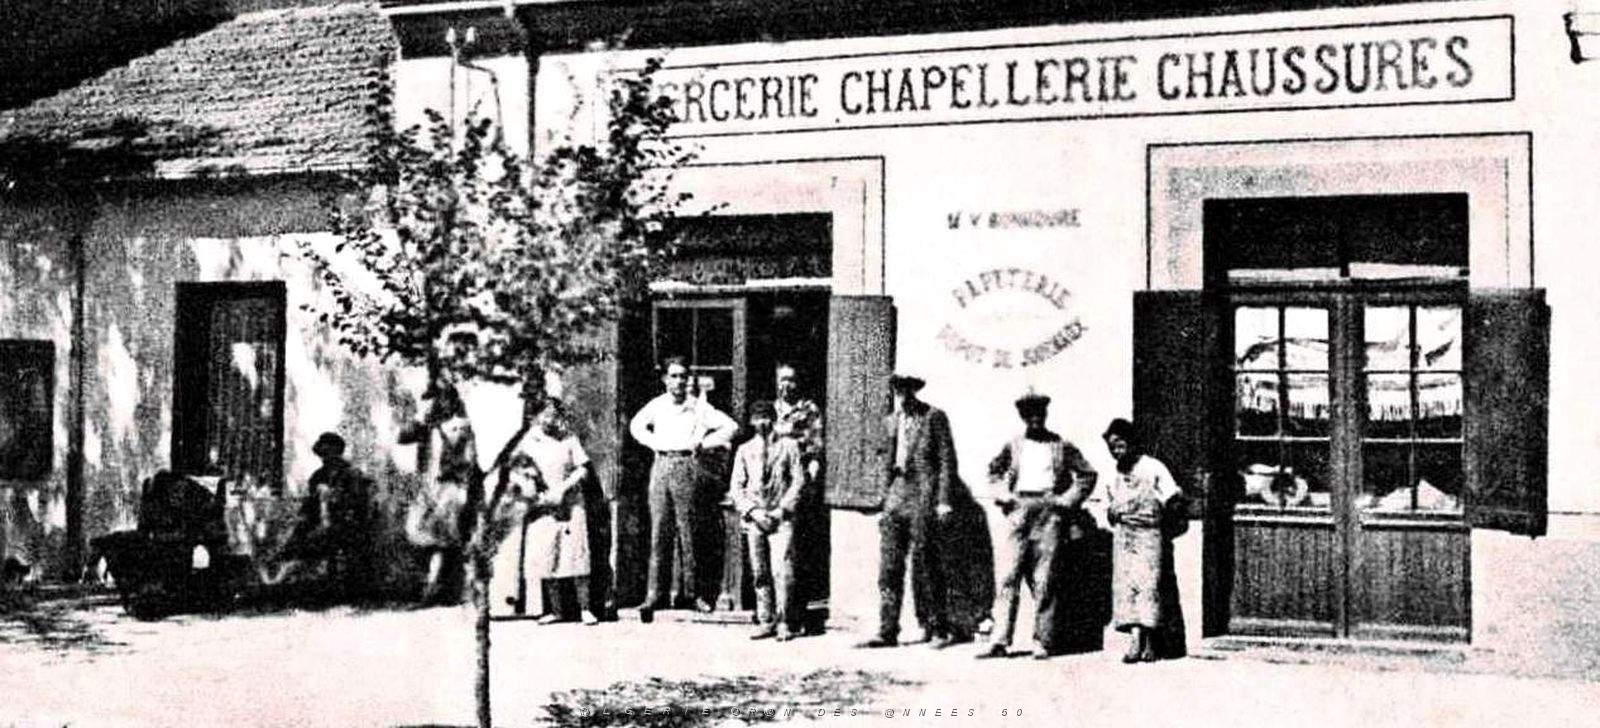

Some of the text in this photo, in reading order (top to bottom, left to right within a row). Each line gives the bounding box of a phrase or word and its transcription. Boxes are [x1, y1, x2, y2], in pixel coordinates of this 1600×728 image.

[652, 35, 1474, 124] RCERIE CHAPELLERIE CHAUSSURES
[952, 267, 1072, 310] PAPETERIE
